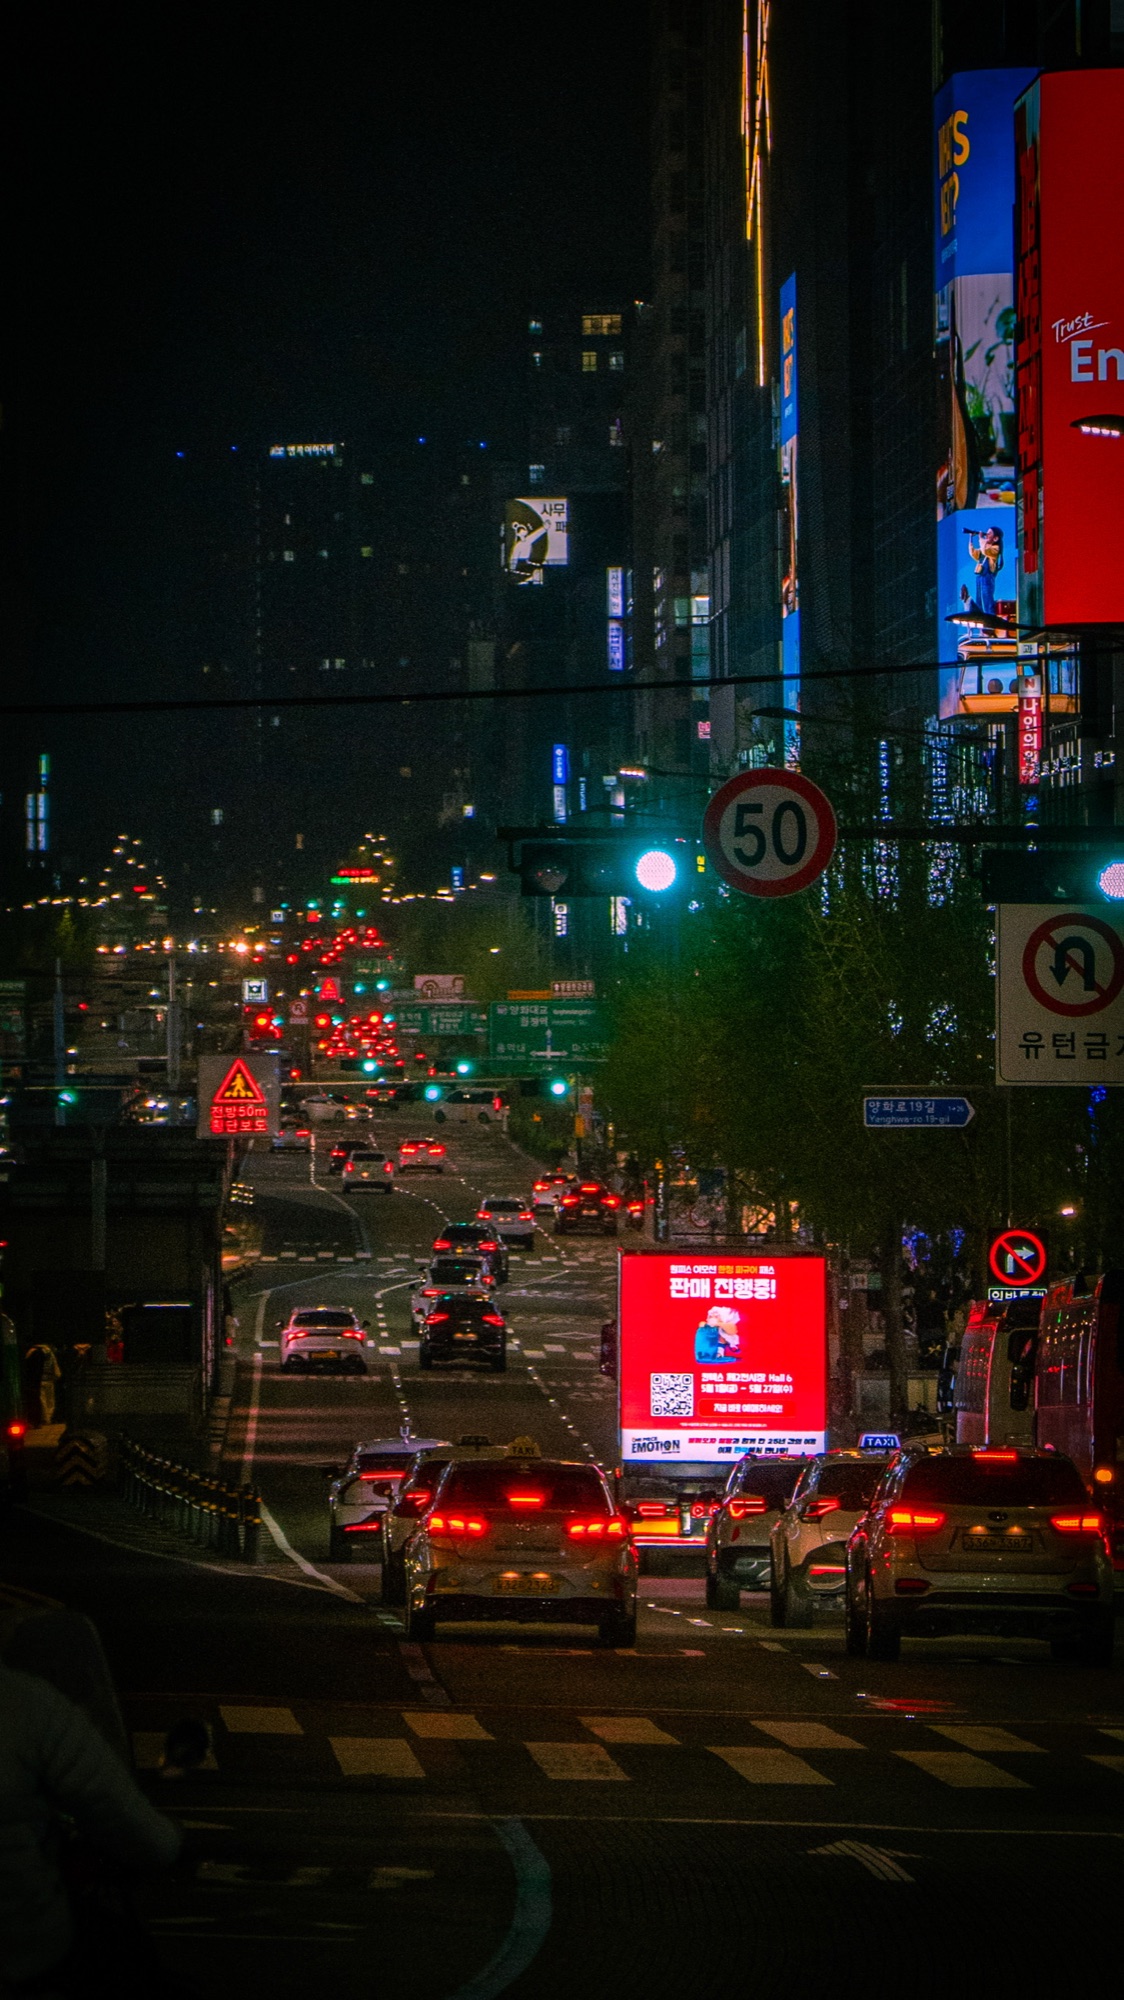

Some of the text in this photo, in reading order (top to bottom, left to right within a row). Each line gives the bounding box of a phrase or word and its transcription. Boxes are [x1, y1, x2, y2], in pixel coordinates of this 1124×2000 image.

[1051, 312, 1094, 343] Trust
[733, 800, 807, 867] 50
[669, 1278, 776, 1300] 판매 진행중!
[768, 1373, 785, 1382] Hall
[786, 1374, 793, 1383] 6
[631, 1440, 680, 1454] EMOTION
[866, 1438, 895, 1447] TAXI
